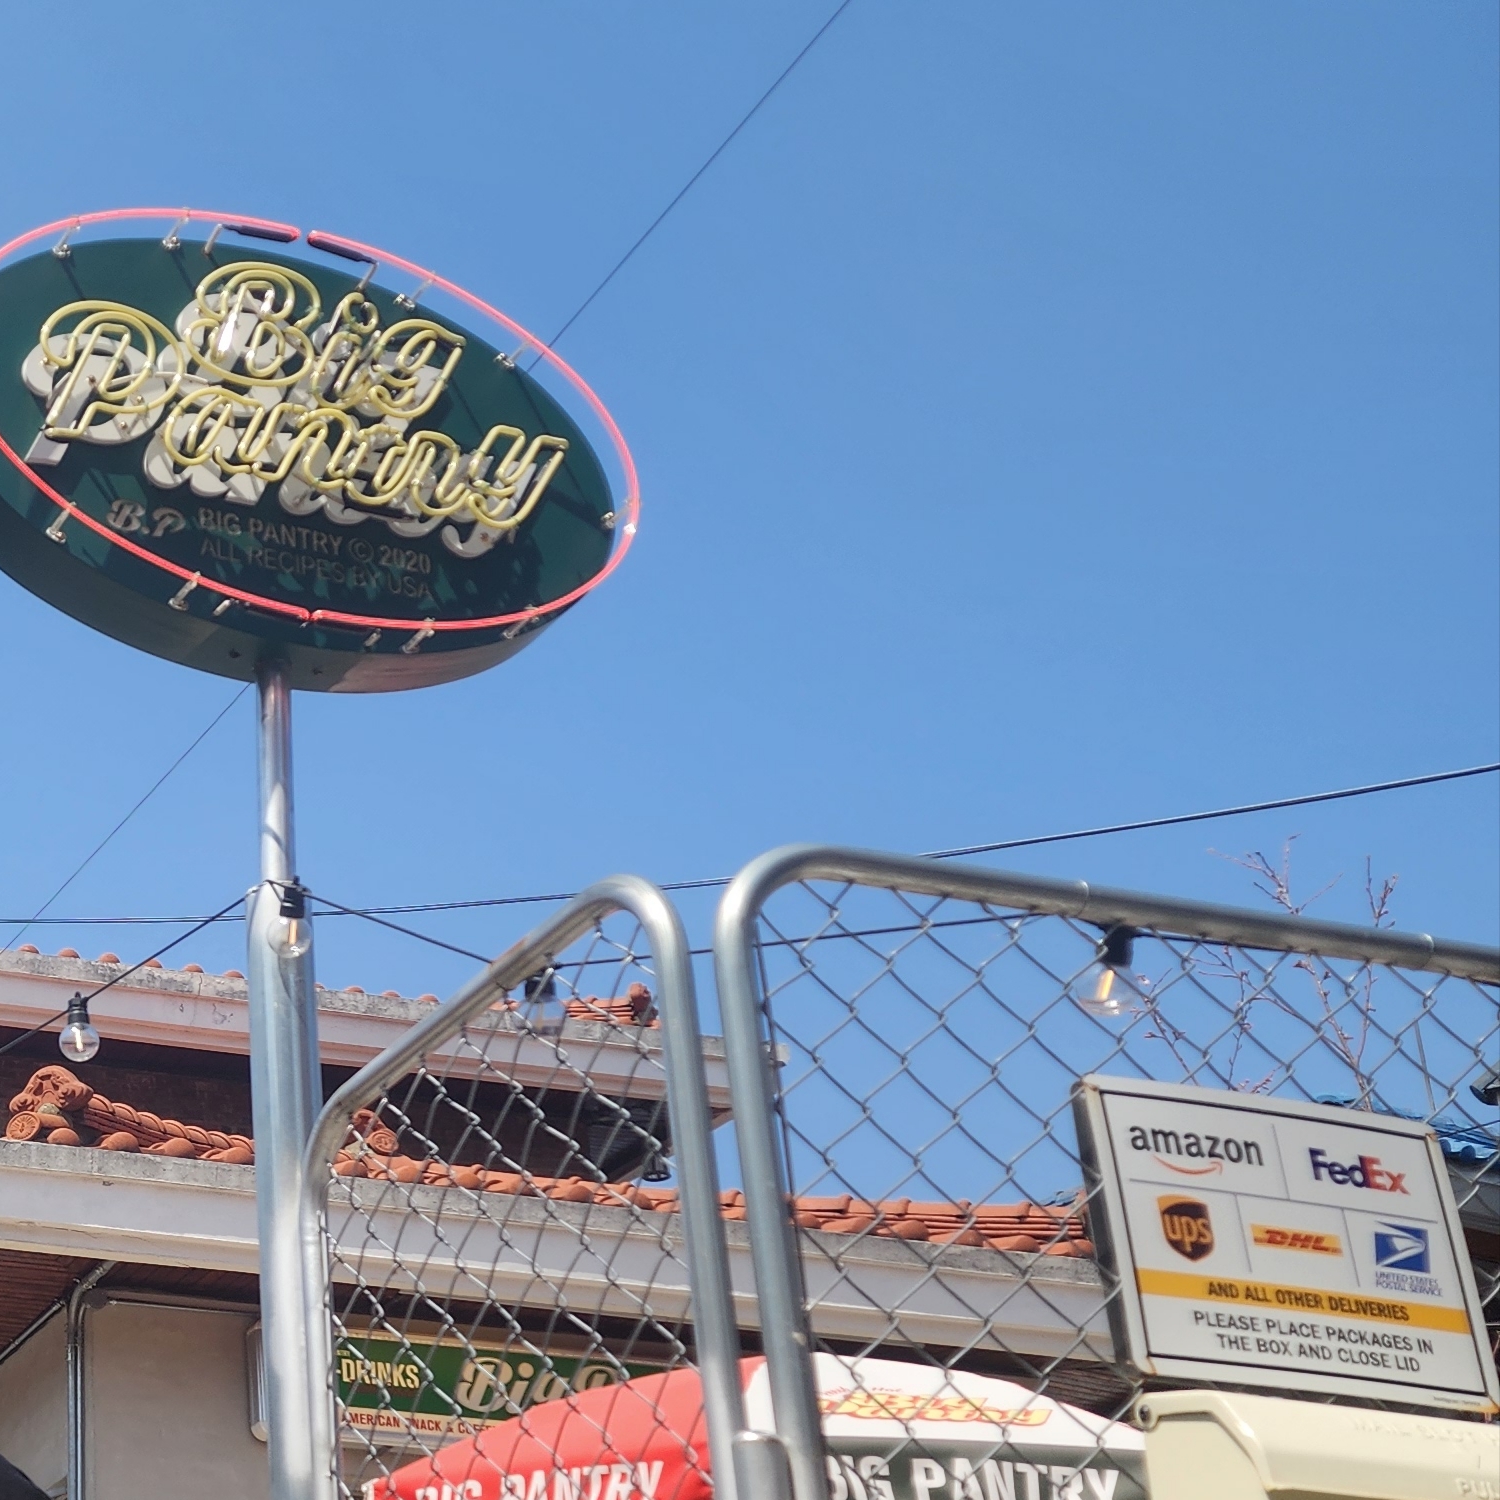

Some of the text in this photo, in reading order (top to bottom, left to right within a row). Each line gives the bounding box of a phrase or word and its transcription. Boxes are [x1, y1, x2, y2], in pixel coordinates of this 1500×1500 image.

[180, 261, 467, 420] Big
[199, 507, 242, 535] BIG
[250, 519, 343, 555] PANTRY
[378, 545, 433, 574] 2020
[201, 536, 241, 563] ALL
[249, 548, 345, 583] RECIPES
[386, 570, 434, 598] USA
[1129, 1125, 1265, 1166] amazon
[1308, 1147, 1412, 1195] FedEx
[1163, 1214, 1212, 1252] ups
[1263, 1228, 1329, 1251] DHL
[1375, 1271, 1438, 1287] UNITED STATES
[1375, 1279, 1444, 1297] POSTAL SERVICE
[1208, 1281, 1410, 1322] AND ALL OTHER DELIVERIES
[1193, 1310, 1434, 1354] PLEASE PLACE PACKAGES IN
[1216, 1333, 1420, 1372] THE BOX AND CLOSE LID
